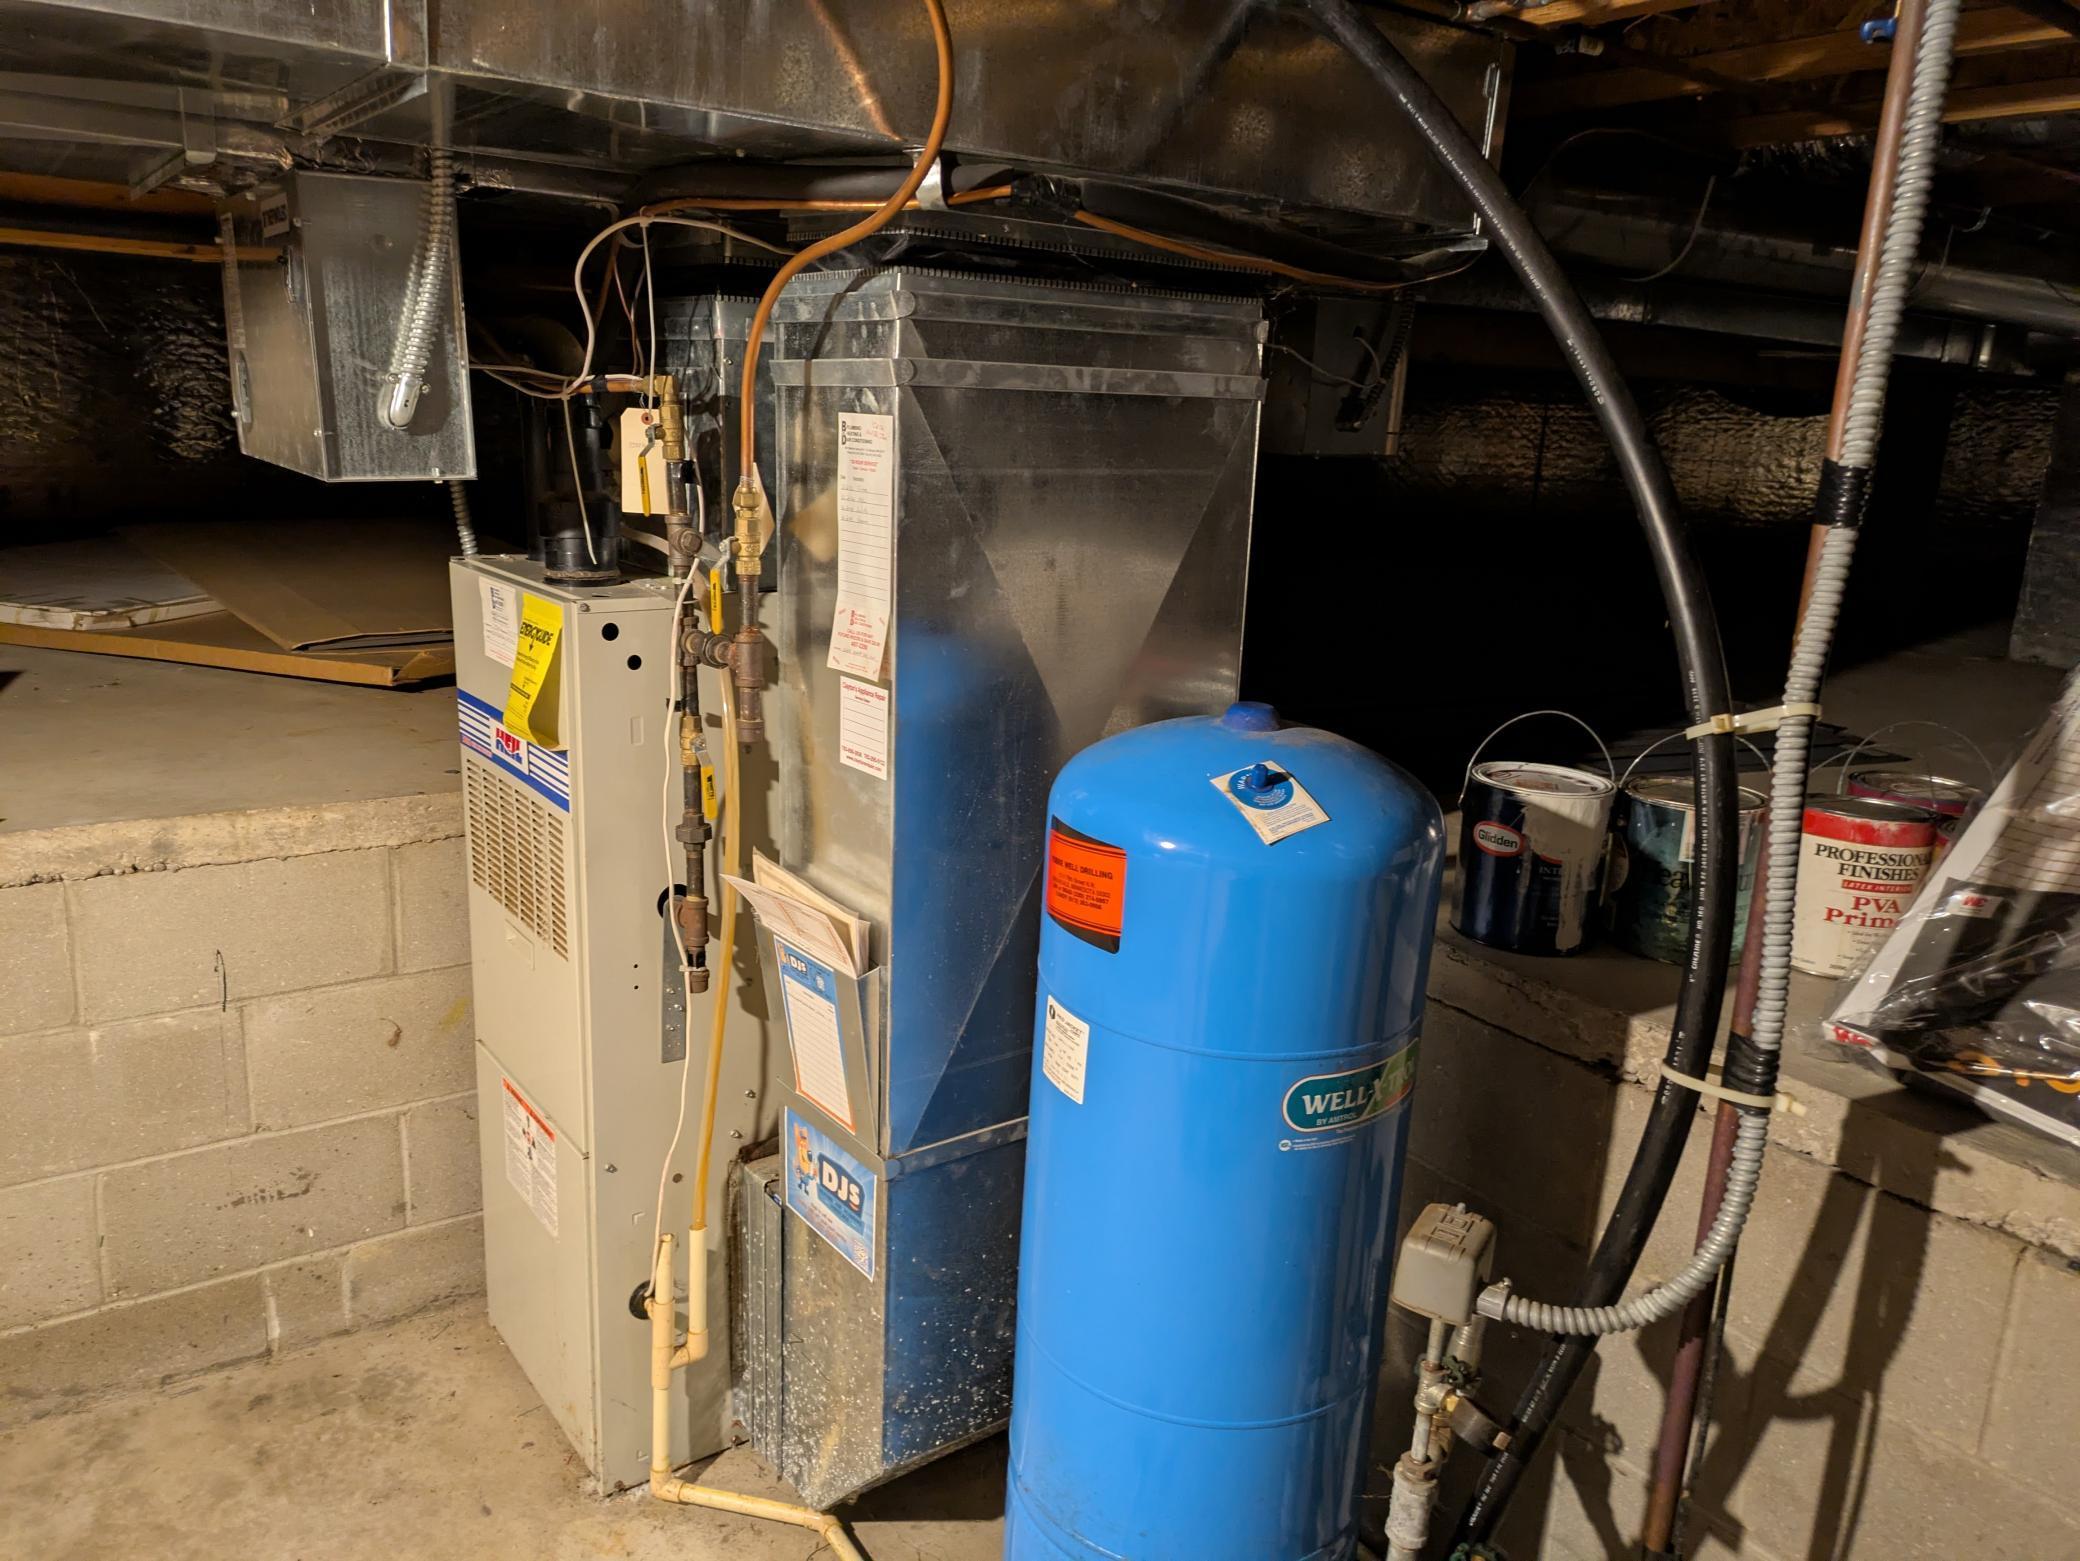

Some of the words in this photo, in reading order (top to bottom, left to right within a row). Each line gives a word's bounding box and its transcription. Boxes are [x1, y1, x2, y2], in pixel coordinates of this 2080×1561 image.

[1478, 829, 1518, 849] Glidden
[1837, 862, 1919, 882] FINISHES
[1851, 895, 1902, 914] PVA
[821, 1160, 861, 1208] DJS
